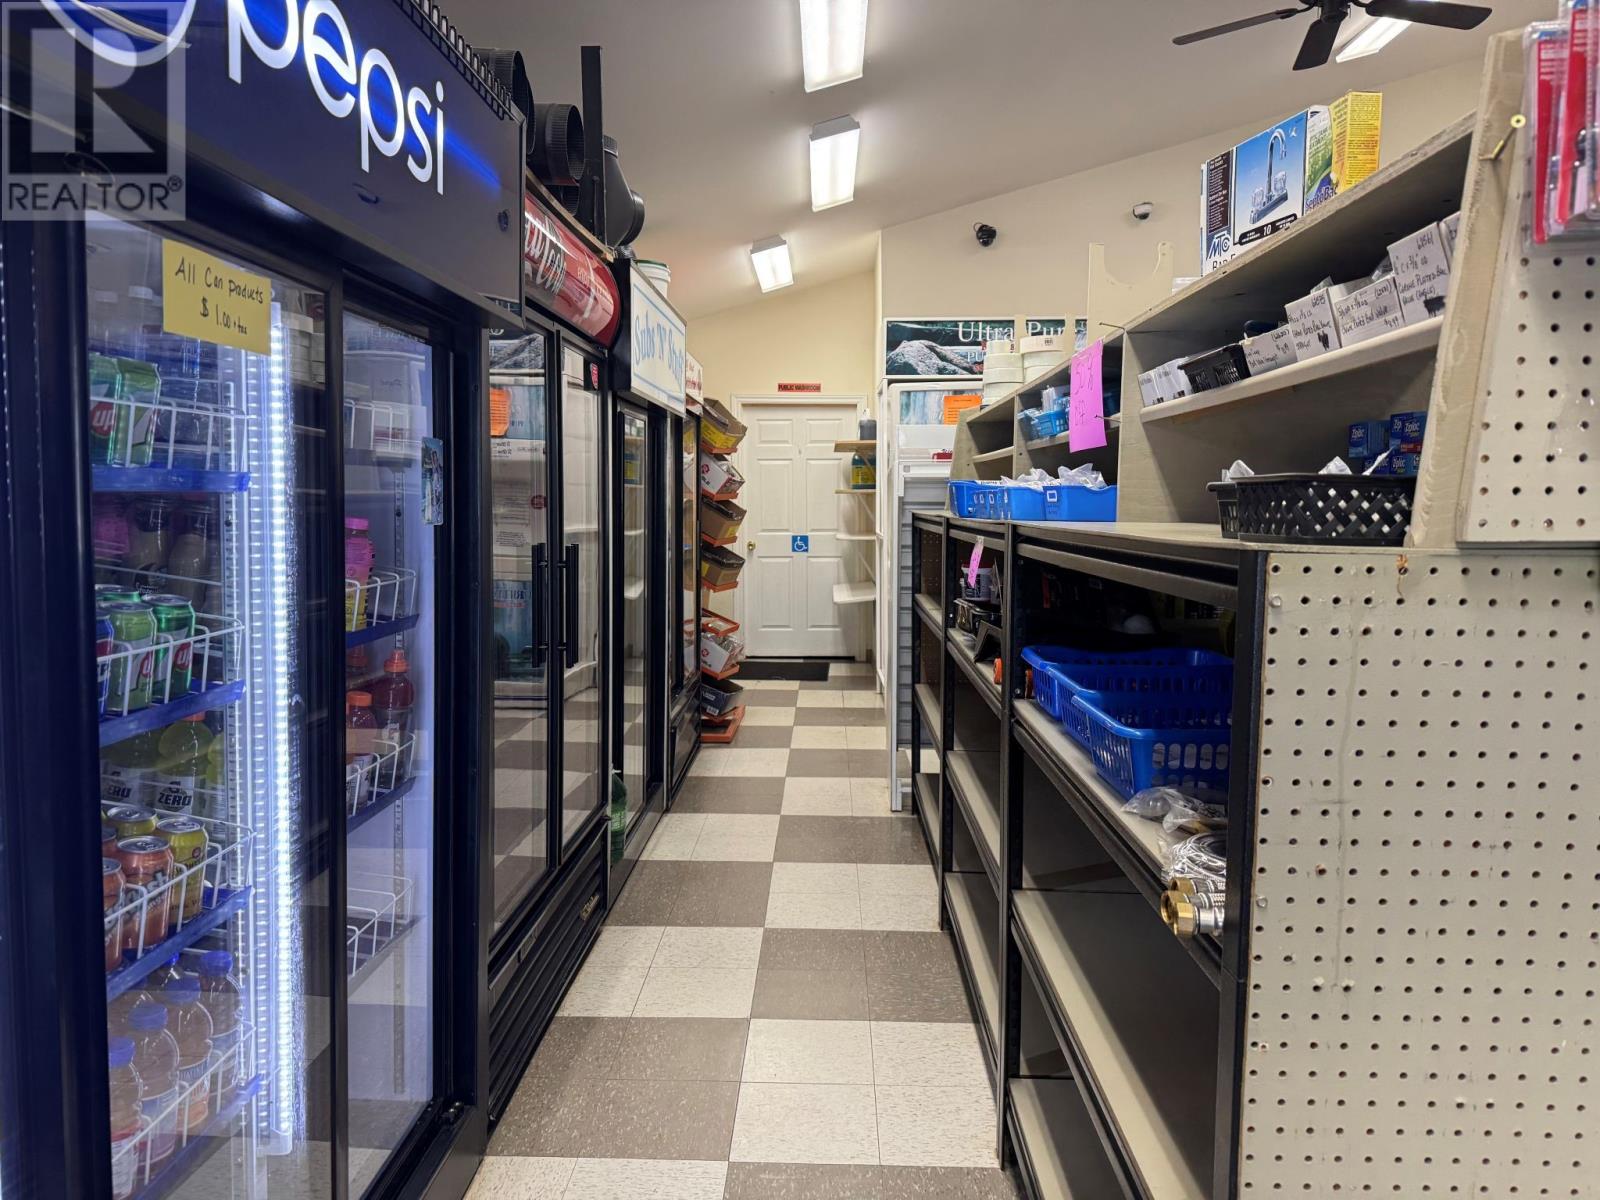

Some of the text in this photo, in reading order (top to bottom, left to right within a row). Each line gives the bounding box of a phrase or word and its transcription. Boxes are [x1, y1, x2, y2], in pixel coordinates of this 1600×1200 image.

[228, 0, 444, 195] pepsi
[175, 257, 196, 285] All
[204, 266, 223, 289] Can
[199, 296, 210, 318] $
[215, 303, 231, 329] 1.00
[634, 309, 655, 366] Subs
[957, 321, 1066, 342] Ultra Pur
[159, 791, 192, 806] ZERO
